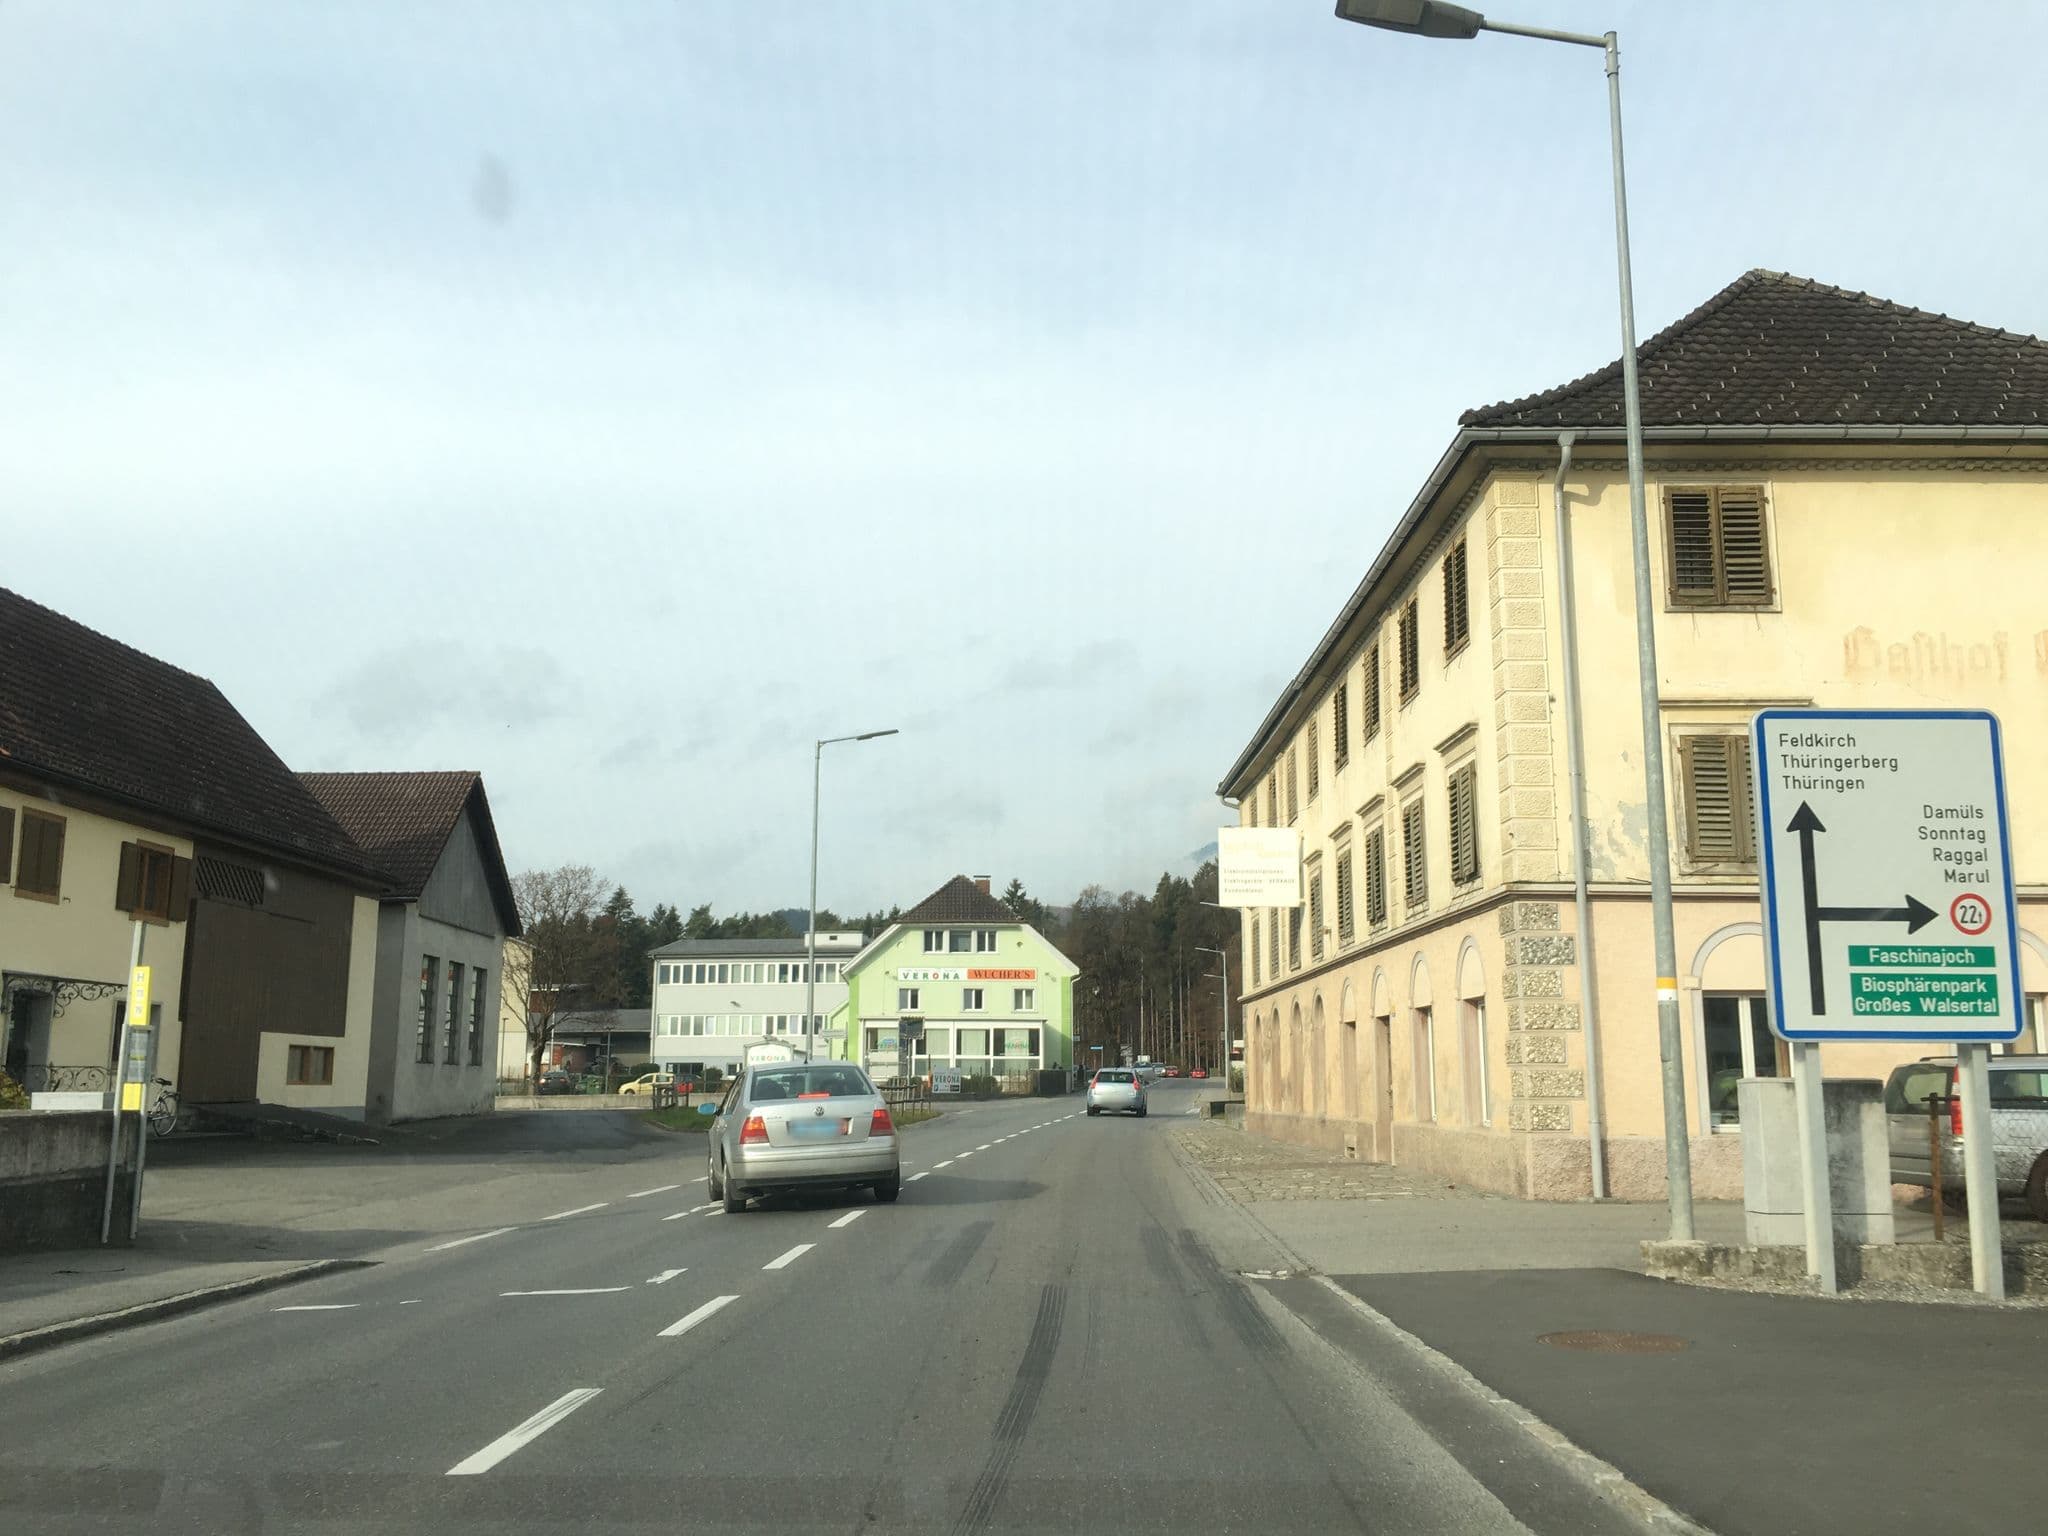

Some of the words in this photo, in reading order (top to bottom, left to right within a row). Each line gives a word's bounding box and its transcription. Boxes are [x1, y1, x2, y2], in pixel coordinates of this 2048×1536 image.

[1779, 733, 1856, 748] Feldkirch
[1780, 754, 1899, 772] Thüringerberg
[1782, 775, 1865, 793] Thüringen
[1923, 804, 1984, 820] Damüls
[1917, 826, 1986, 844] Sonntag
[1933, 847, 1988, 866] Raggal
[1944, 869, 1990, 884] Marul
[1869, 948, 1975, 967] Faschinajoch
[902, 972, 960, 980] VERONA
[974, 969, 1031, 979] WUCHER'S
[1861, 976, 1987, 995] Biosphärenpark
[1854, 997, 1911, 1013] Großes
[1920, 997, 1997, 1013] Walsertal
